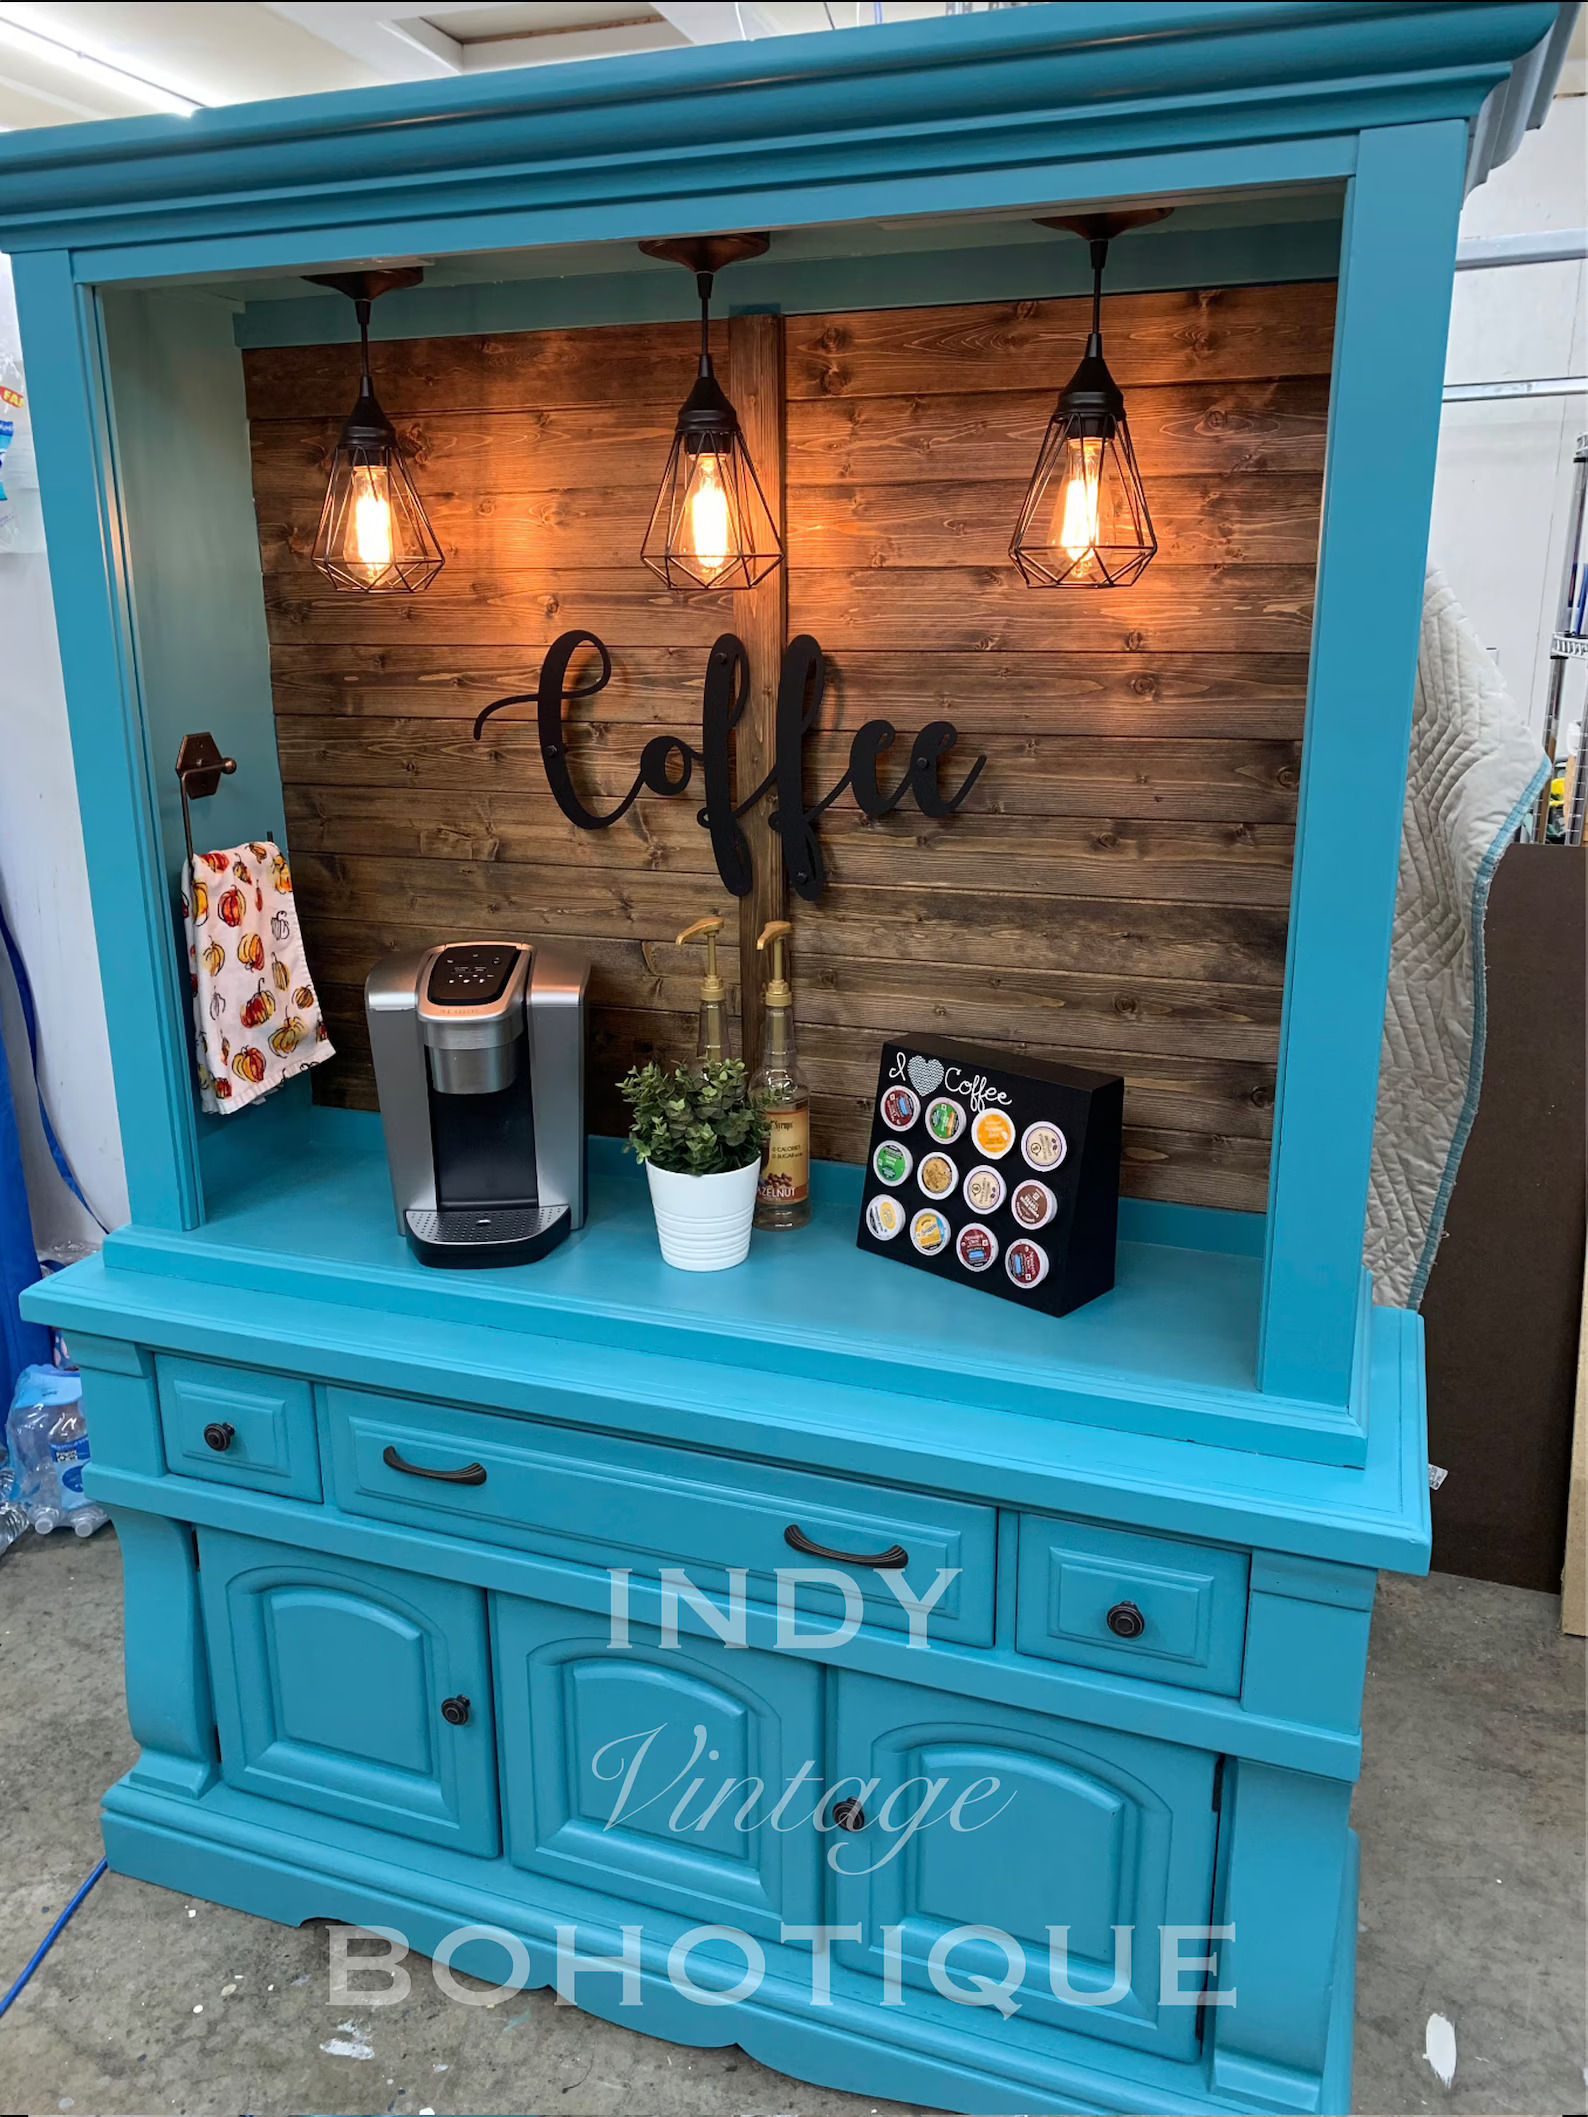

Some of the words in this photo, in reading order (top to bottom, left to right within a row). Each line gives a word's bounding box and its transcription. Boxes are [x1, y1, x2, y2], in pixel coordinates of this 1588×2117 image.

[474, 630, 988, 901] Coffee
[889, 1051, 906, 1082] I
[944, 1067, 1013, 1112] Coffee
